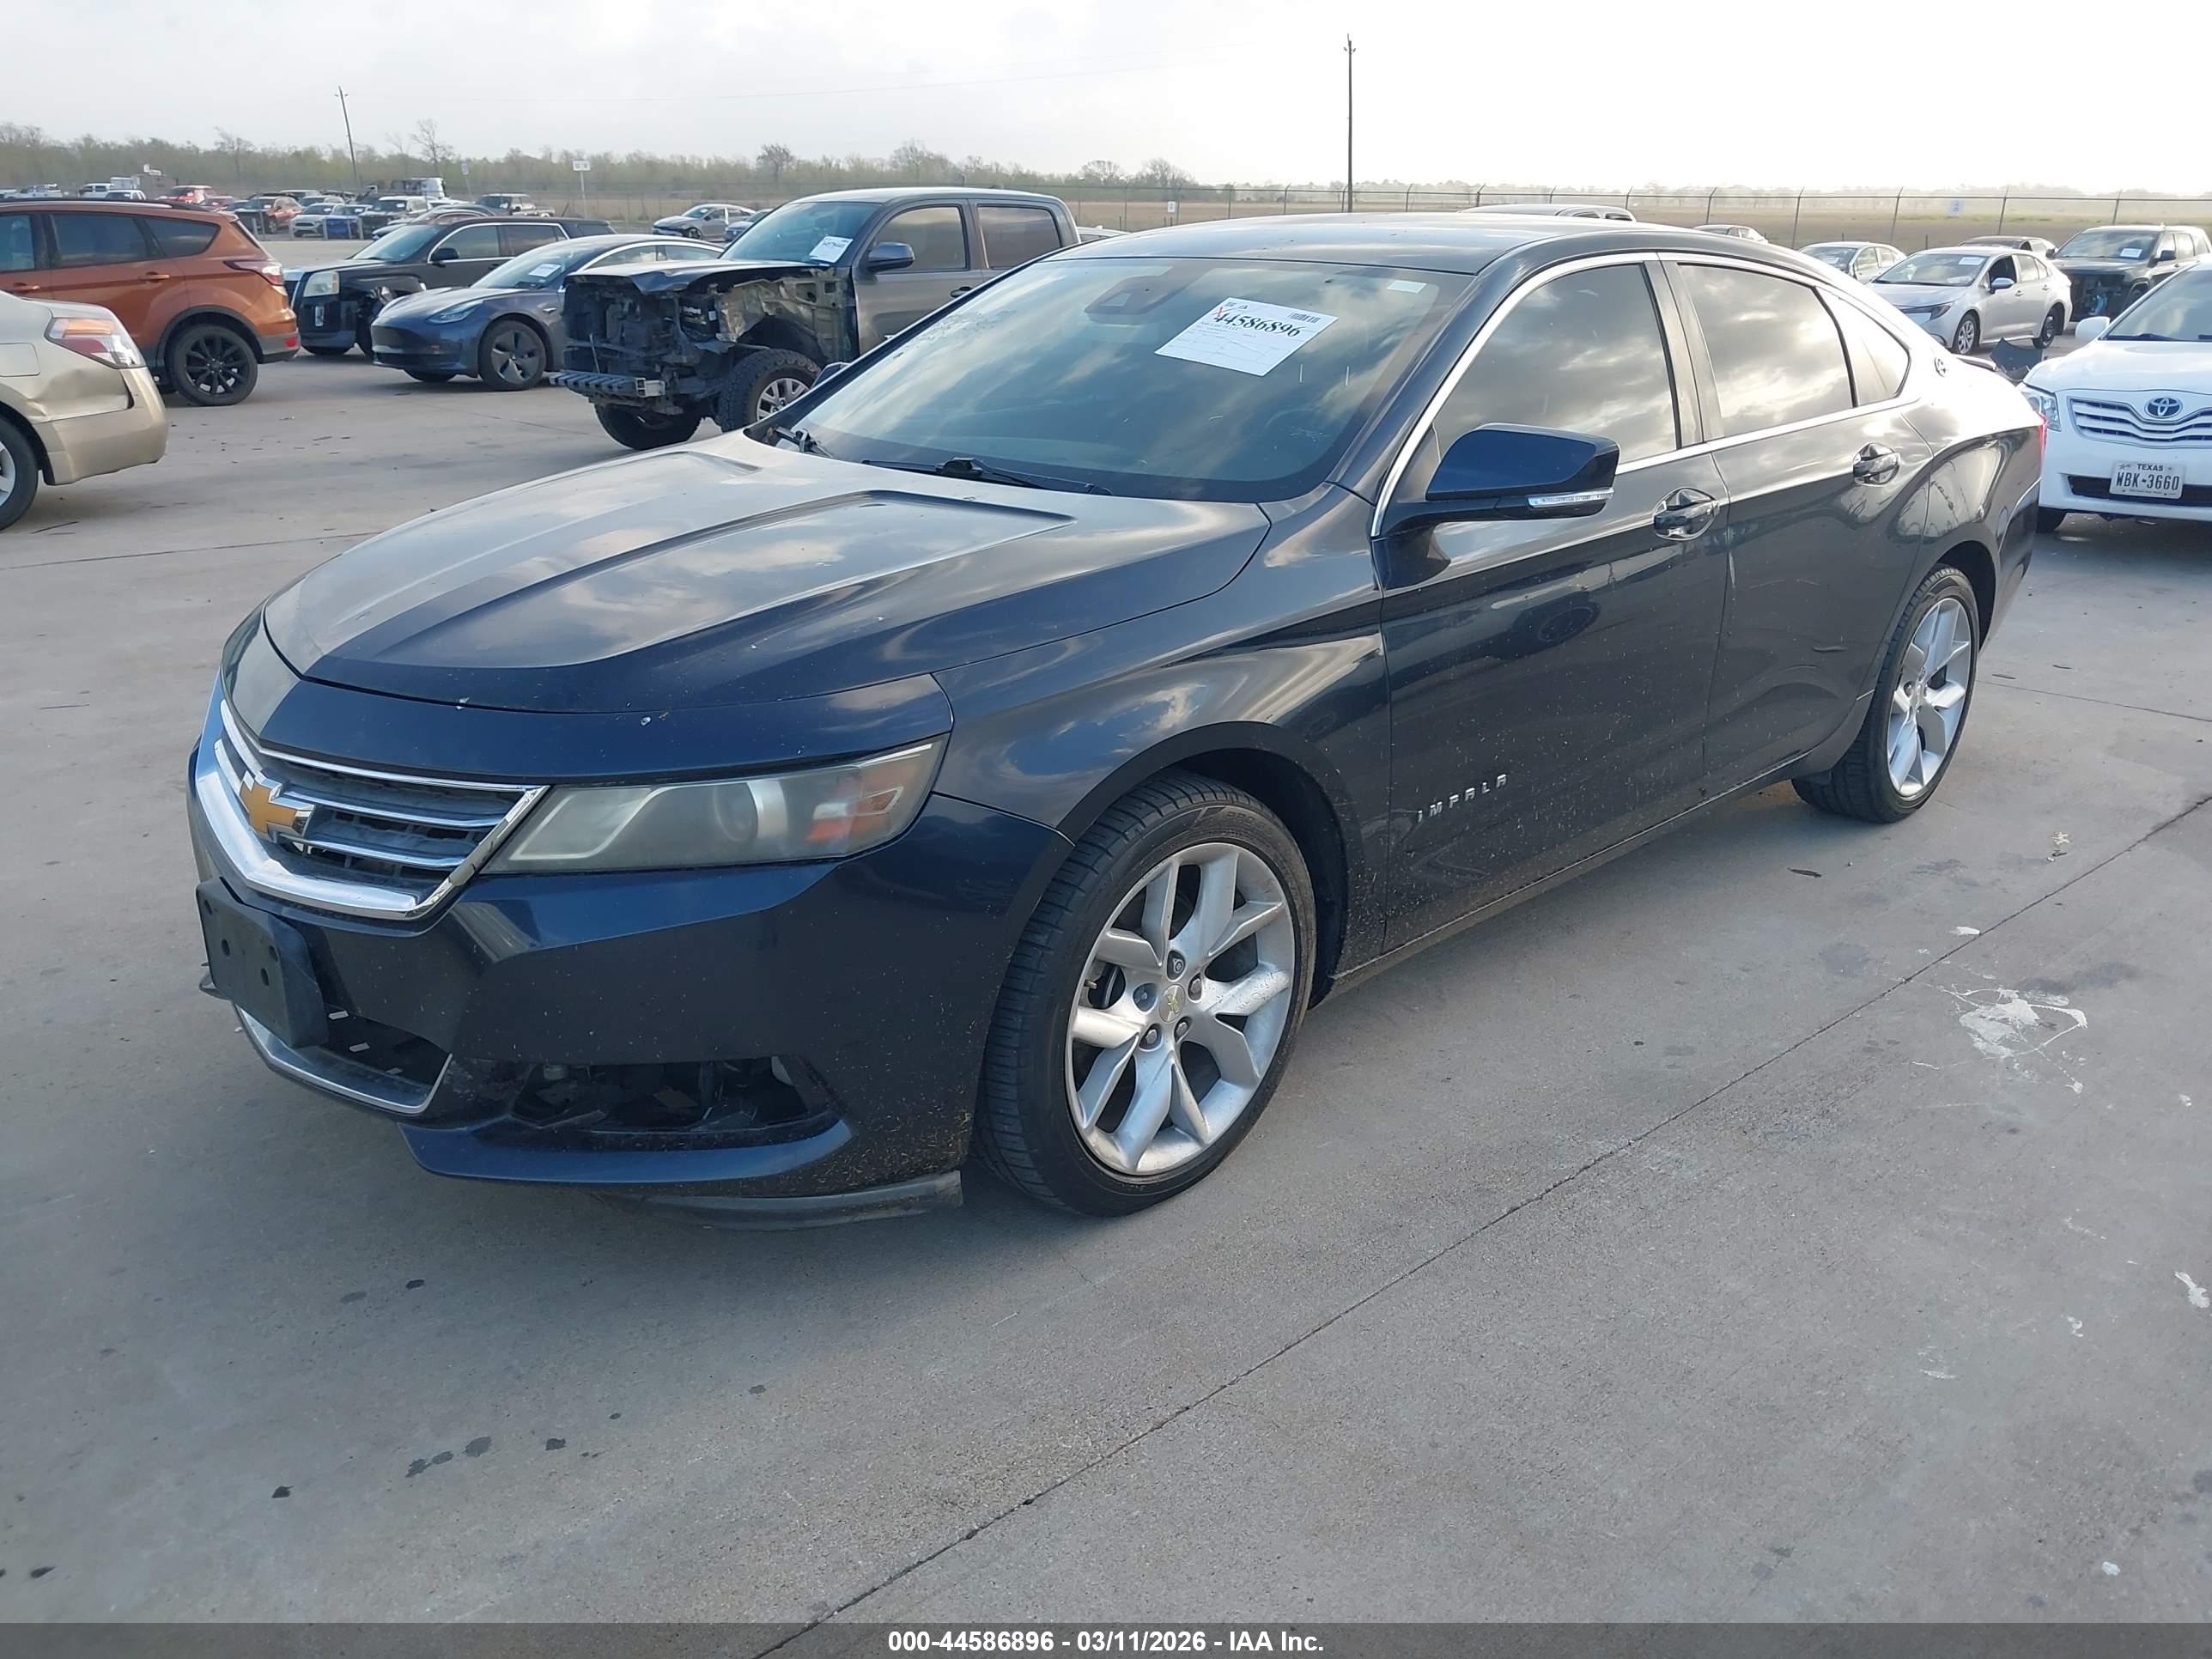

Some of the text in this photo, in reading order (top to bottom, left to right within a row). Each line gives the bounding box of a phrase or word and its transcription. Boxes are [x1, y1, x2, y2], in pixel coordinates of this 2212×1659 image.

[1213, 312, 1306, 337] 44586896
[2137, 463, 2165, 472] TEXAS
[1418, 774, 1507, 823] IMPALA
